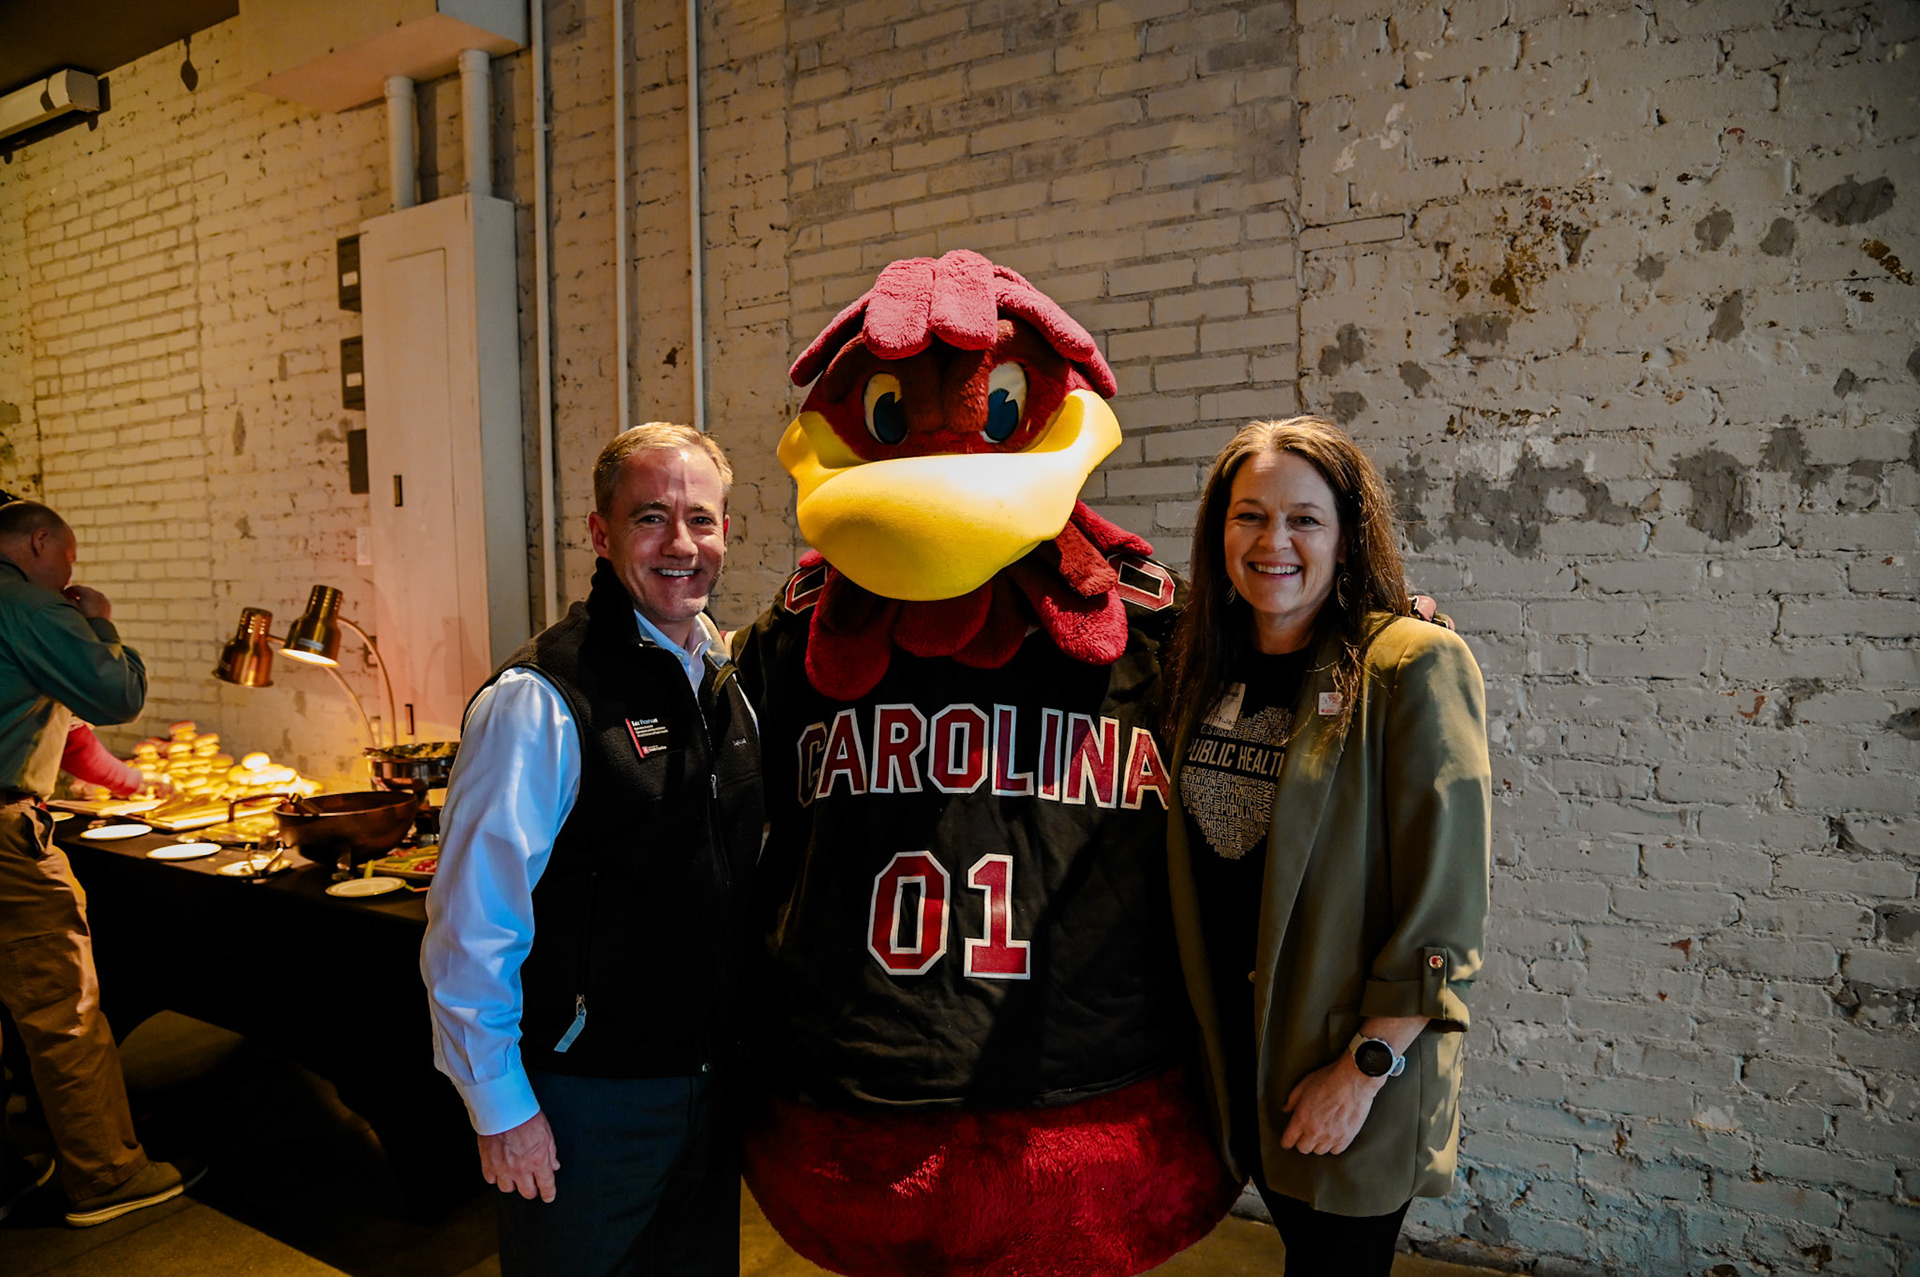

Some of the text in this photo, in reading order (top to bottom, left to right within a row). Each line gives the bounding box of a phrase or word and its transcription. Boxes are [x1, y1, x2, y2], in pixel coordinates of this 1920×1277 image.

[797, 703, 1169, 809] CAROLINA
[1222, 781, 1257, 798] DIAGNOSIS
[1220, 792, 1257, 810] STATISTICS
[1219, 803, 1266, 824] POPULATION
[866, 850, 1030, 979] 01
